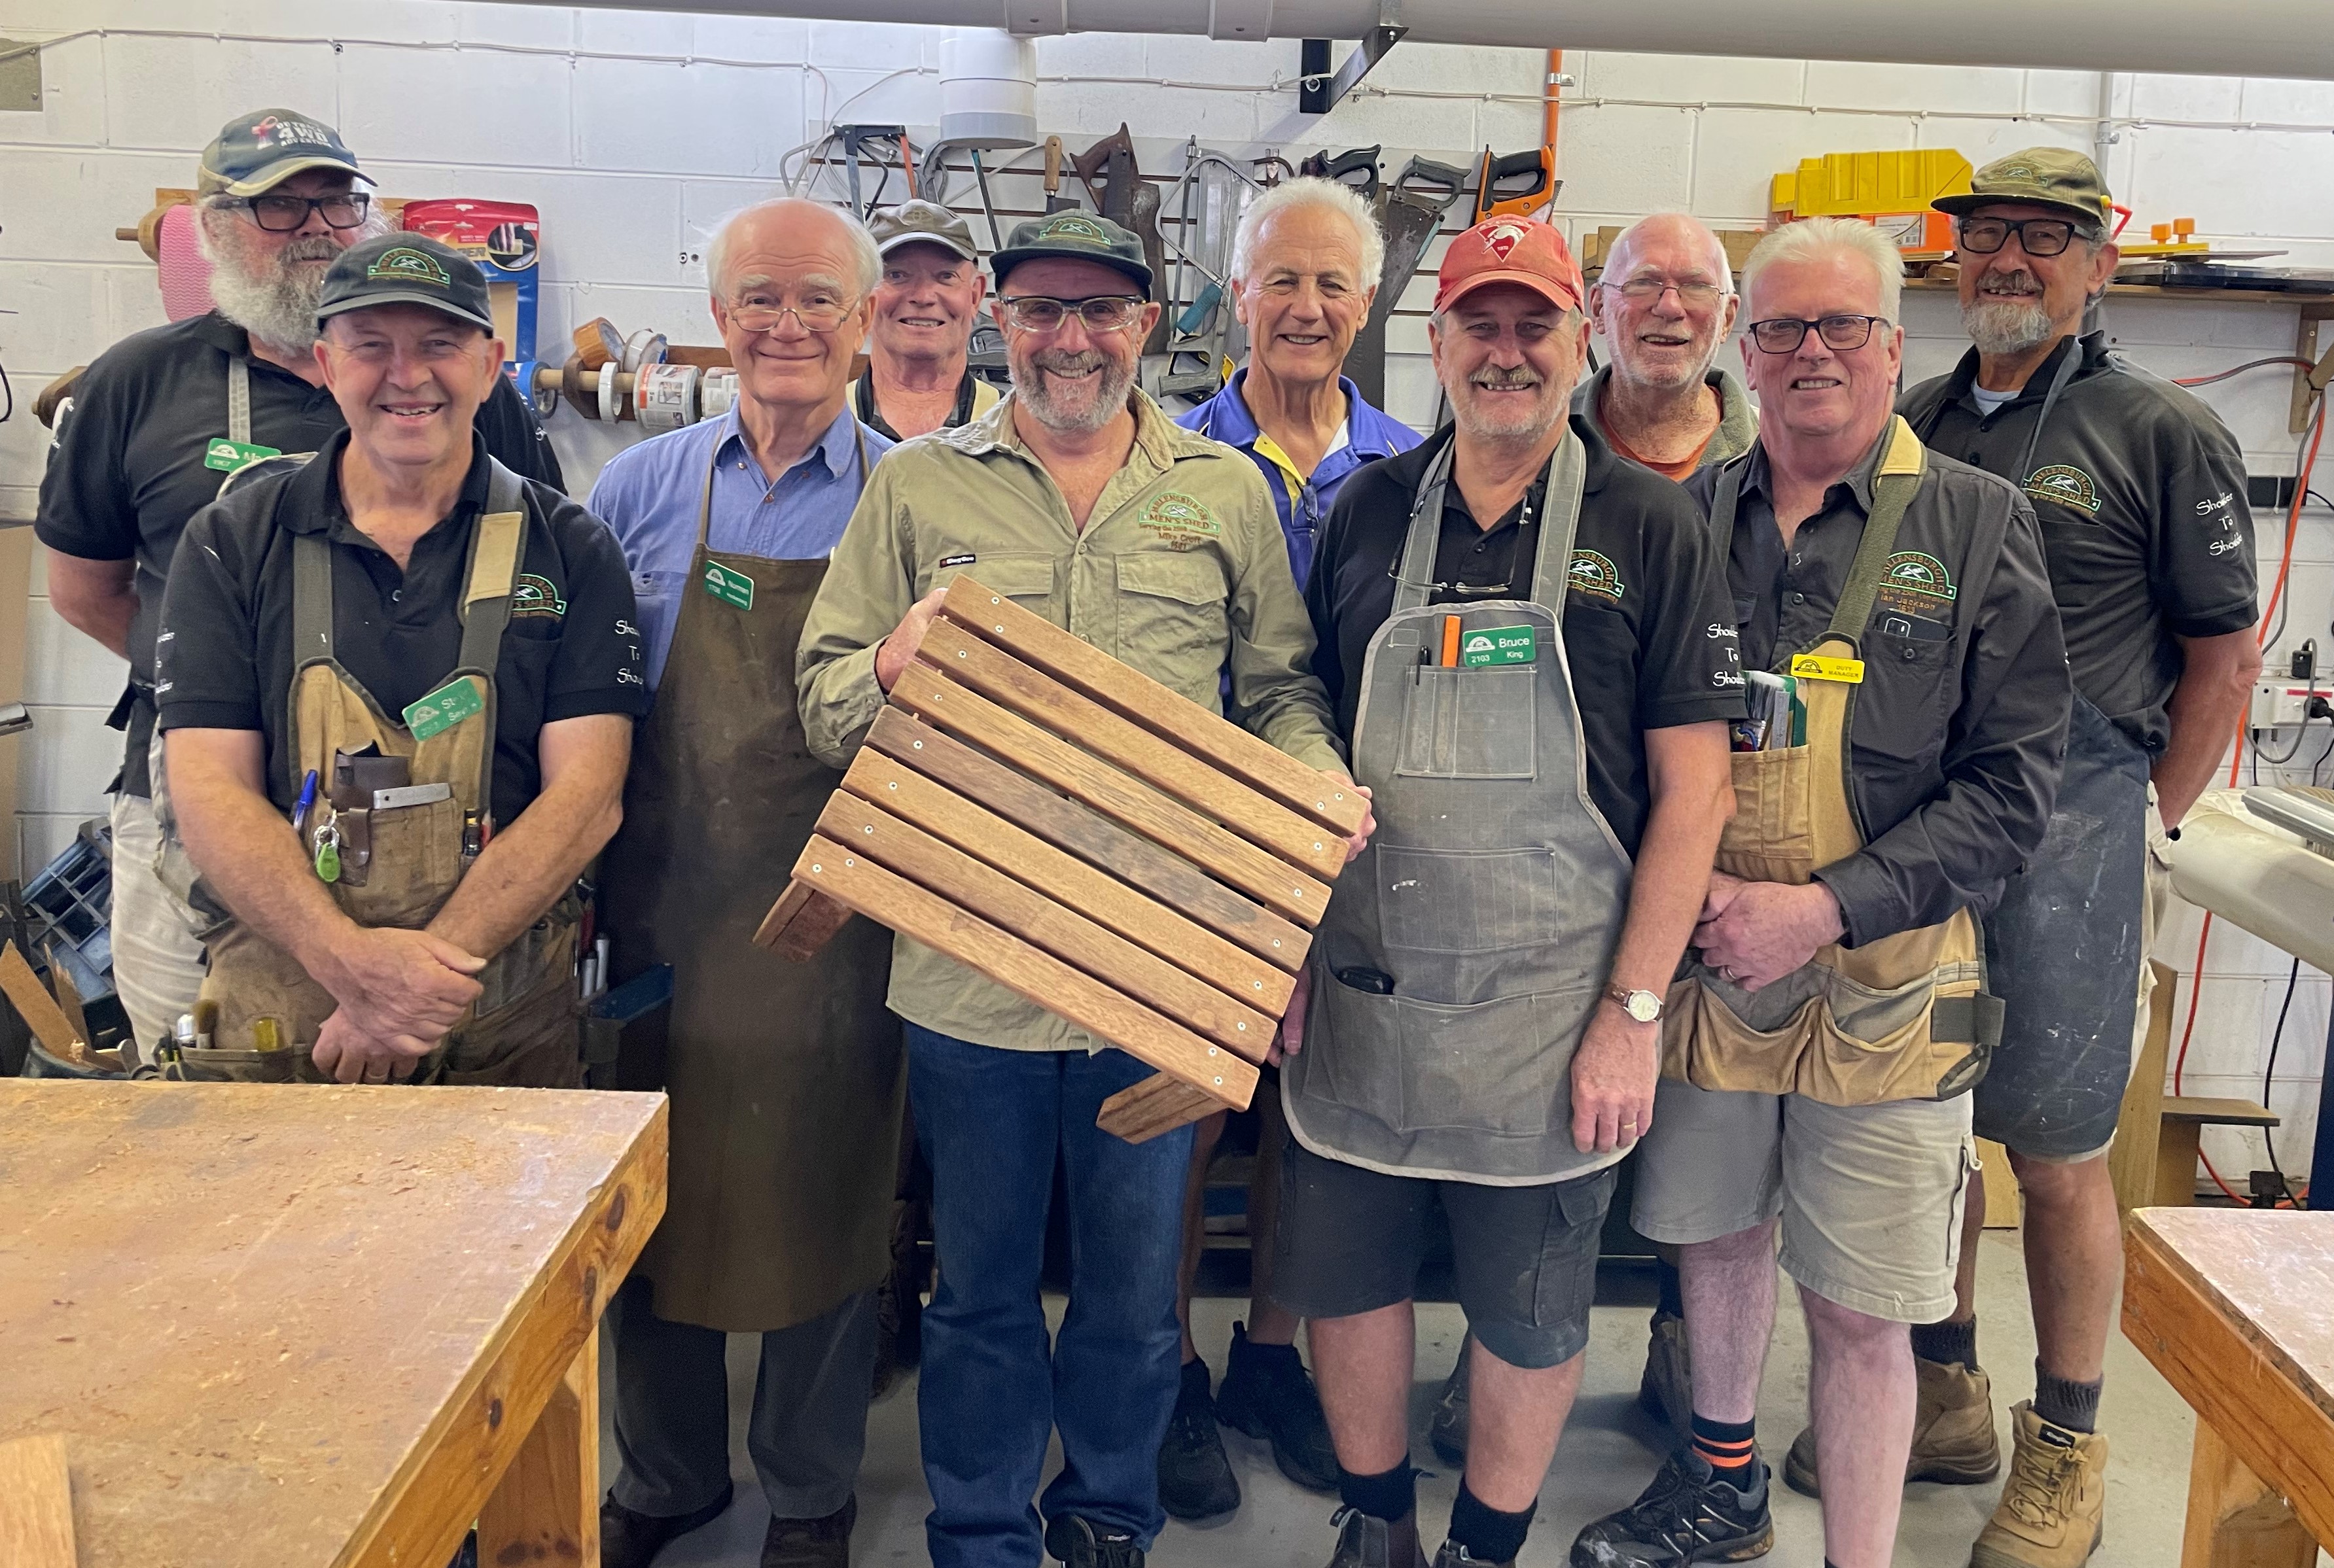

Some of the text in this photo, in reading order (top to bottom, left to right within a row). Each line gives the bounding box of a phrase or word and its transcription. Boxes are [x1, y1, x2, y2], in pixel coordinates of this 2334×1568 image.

[1151, 494, 1209, 521] HELENSBURGH
[1149, 514, 1209, 529] MEN'S SHED
[2218, 515, 2233, 531] To
[1585, 578, 1613, 589] SHED
[1914, 580, 1945, 593] SHED
[1896, 597, 1936, 610] Jackson
[1498, 637, 1530, 648] Bruce
[1470, 654, 1491, 663] 2103
[1724, 647, 1739, 663] To
